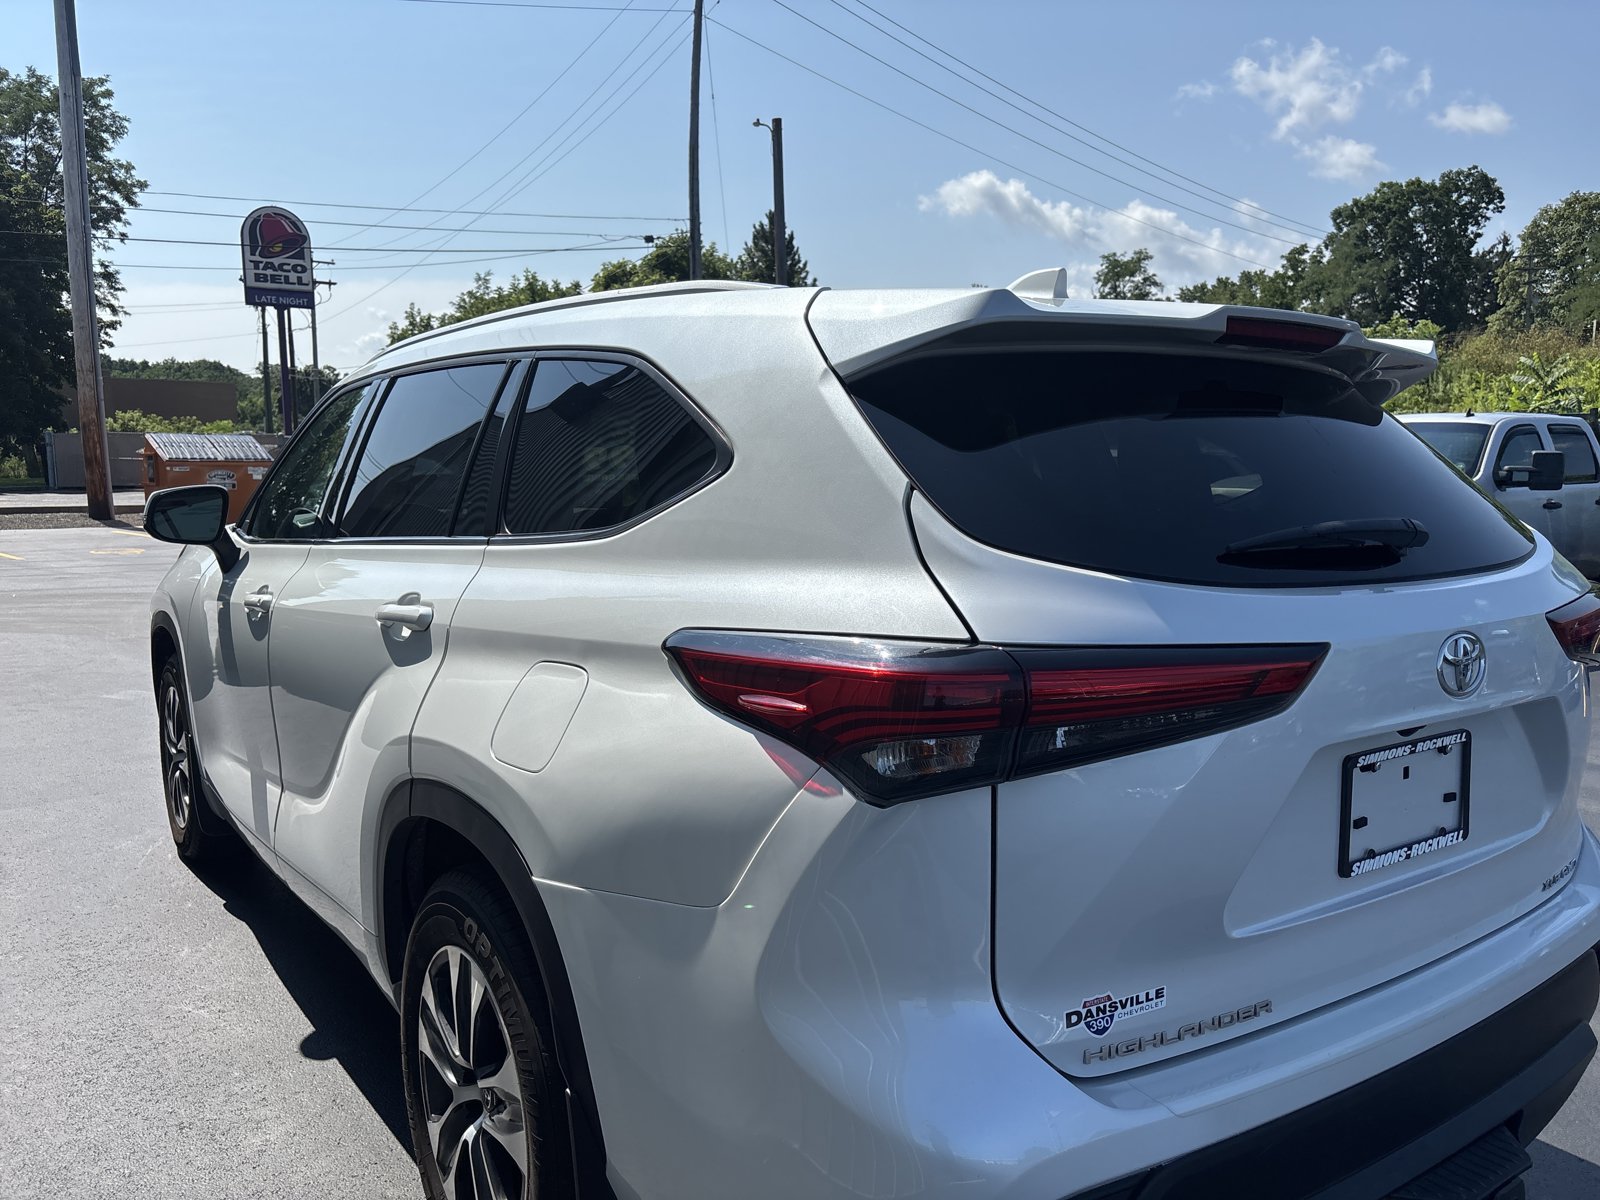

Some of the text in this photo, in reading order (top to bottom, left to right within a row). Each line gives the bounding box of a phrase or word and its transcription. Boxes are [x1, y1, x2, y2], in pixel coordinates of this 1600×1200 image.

[249, 260, 308, 274] TACO
[254, 273, 310, 286] BELL
[255, 295, 308, 306] LATE NIGHT
[1357, 732, 1467, 767] SIMMONS-ROCKWELL
[1351, 830, 1464, 877] SIMMONS-ROCKWELL
[1065, 987, 1165, 1029] DANSVILLE
[1118, 1000, 1164, 1019] CHEVROLET
[1083, 1000, 1273, 1064] HIGHLANDER
[1089, 1017, 1111, 1031] 390
